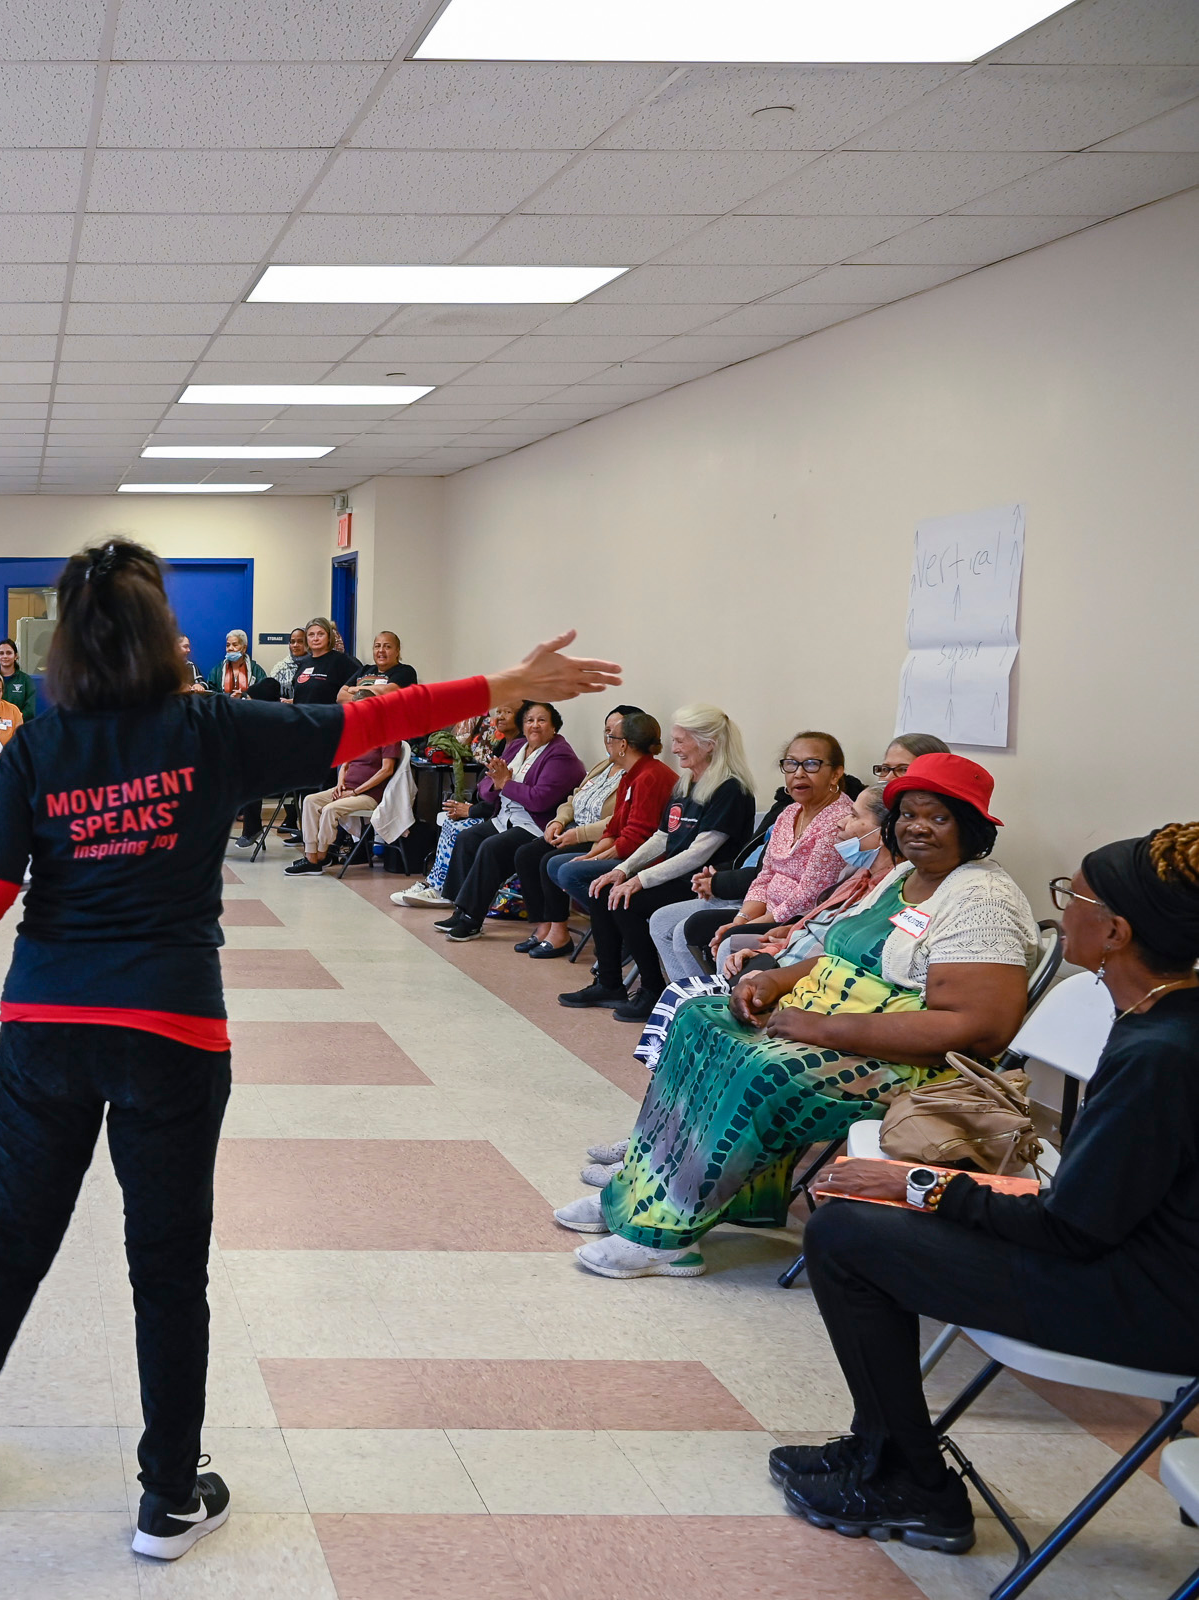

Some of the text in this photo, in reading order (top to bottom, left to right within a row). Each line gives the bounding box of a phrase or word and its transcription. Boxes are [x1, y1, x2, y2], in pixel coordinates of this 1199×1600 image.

[916, 530, 1001, 588] Vertical
[46, 767, 195, 817] MOVEMENT
[69, 801, 176, 842] SPEAKS
[150, 833, 179, 850] Joy
